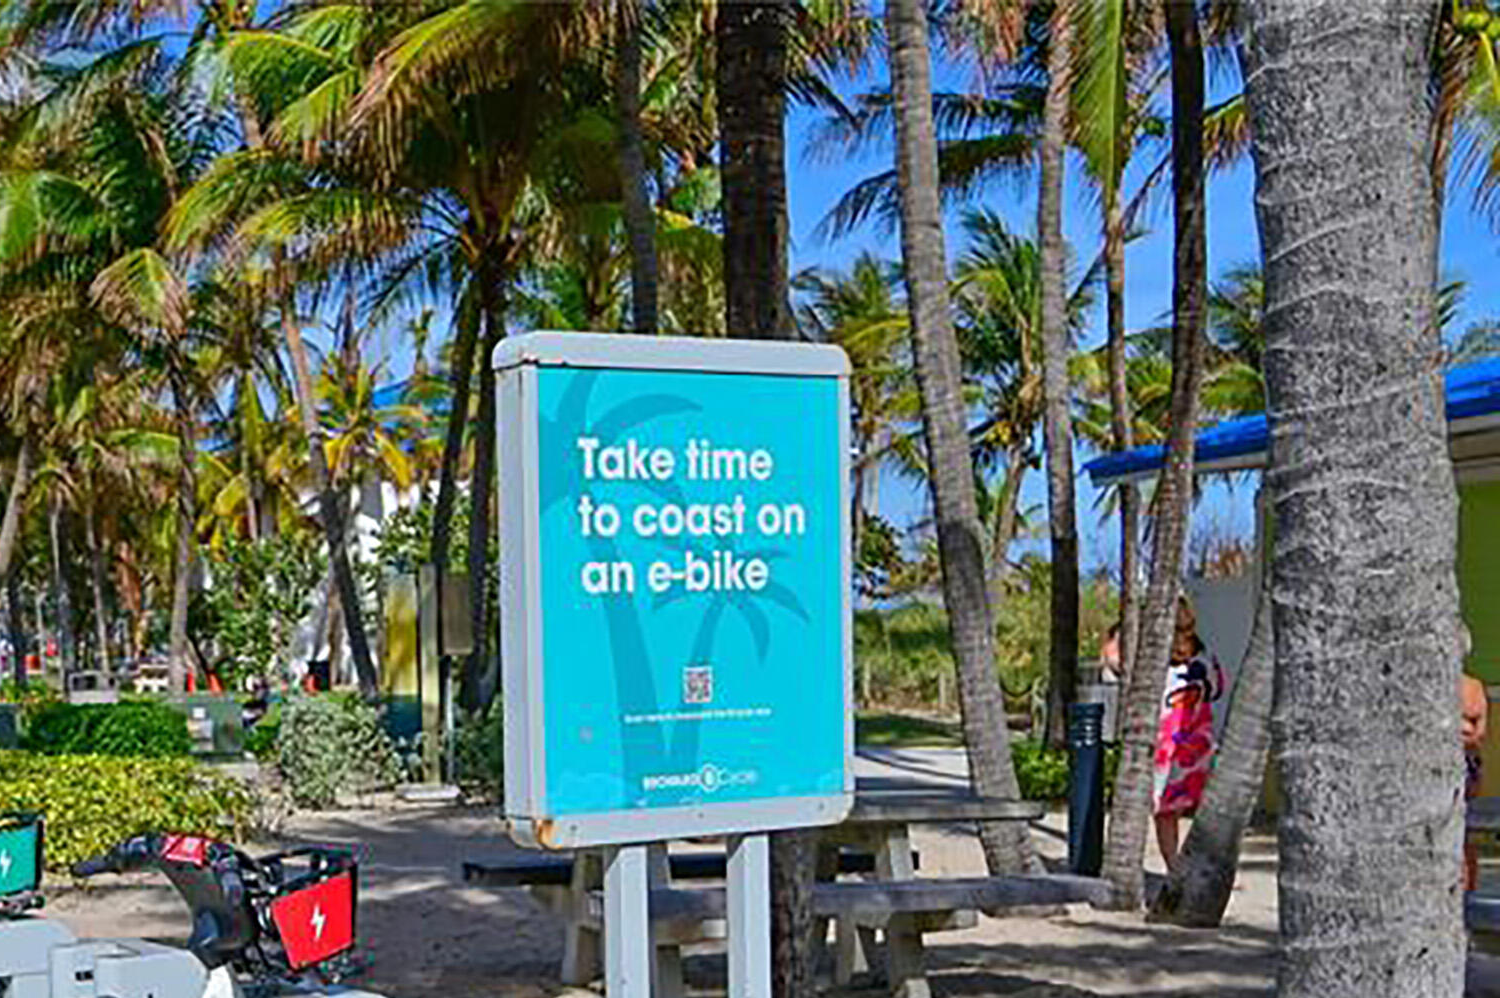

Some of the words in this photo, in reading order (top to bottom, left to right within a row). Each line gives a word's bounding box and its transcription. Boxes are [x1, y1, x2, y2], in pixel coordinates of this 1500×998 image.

[577, 437, 675, 480] Take
[686, 439, 773, 480] time
[577, 495, 621, 536] to
[633, 496, 746, 536] coast
[756, 503, 806, 536] on
[581, 561, 635, 594] an
[647, 550, 769, 592] e-bike
